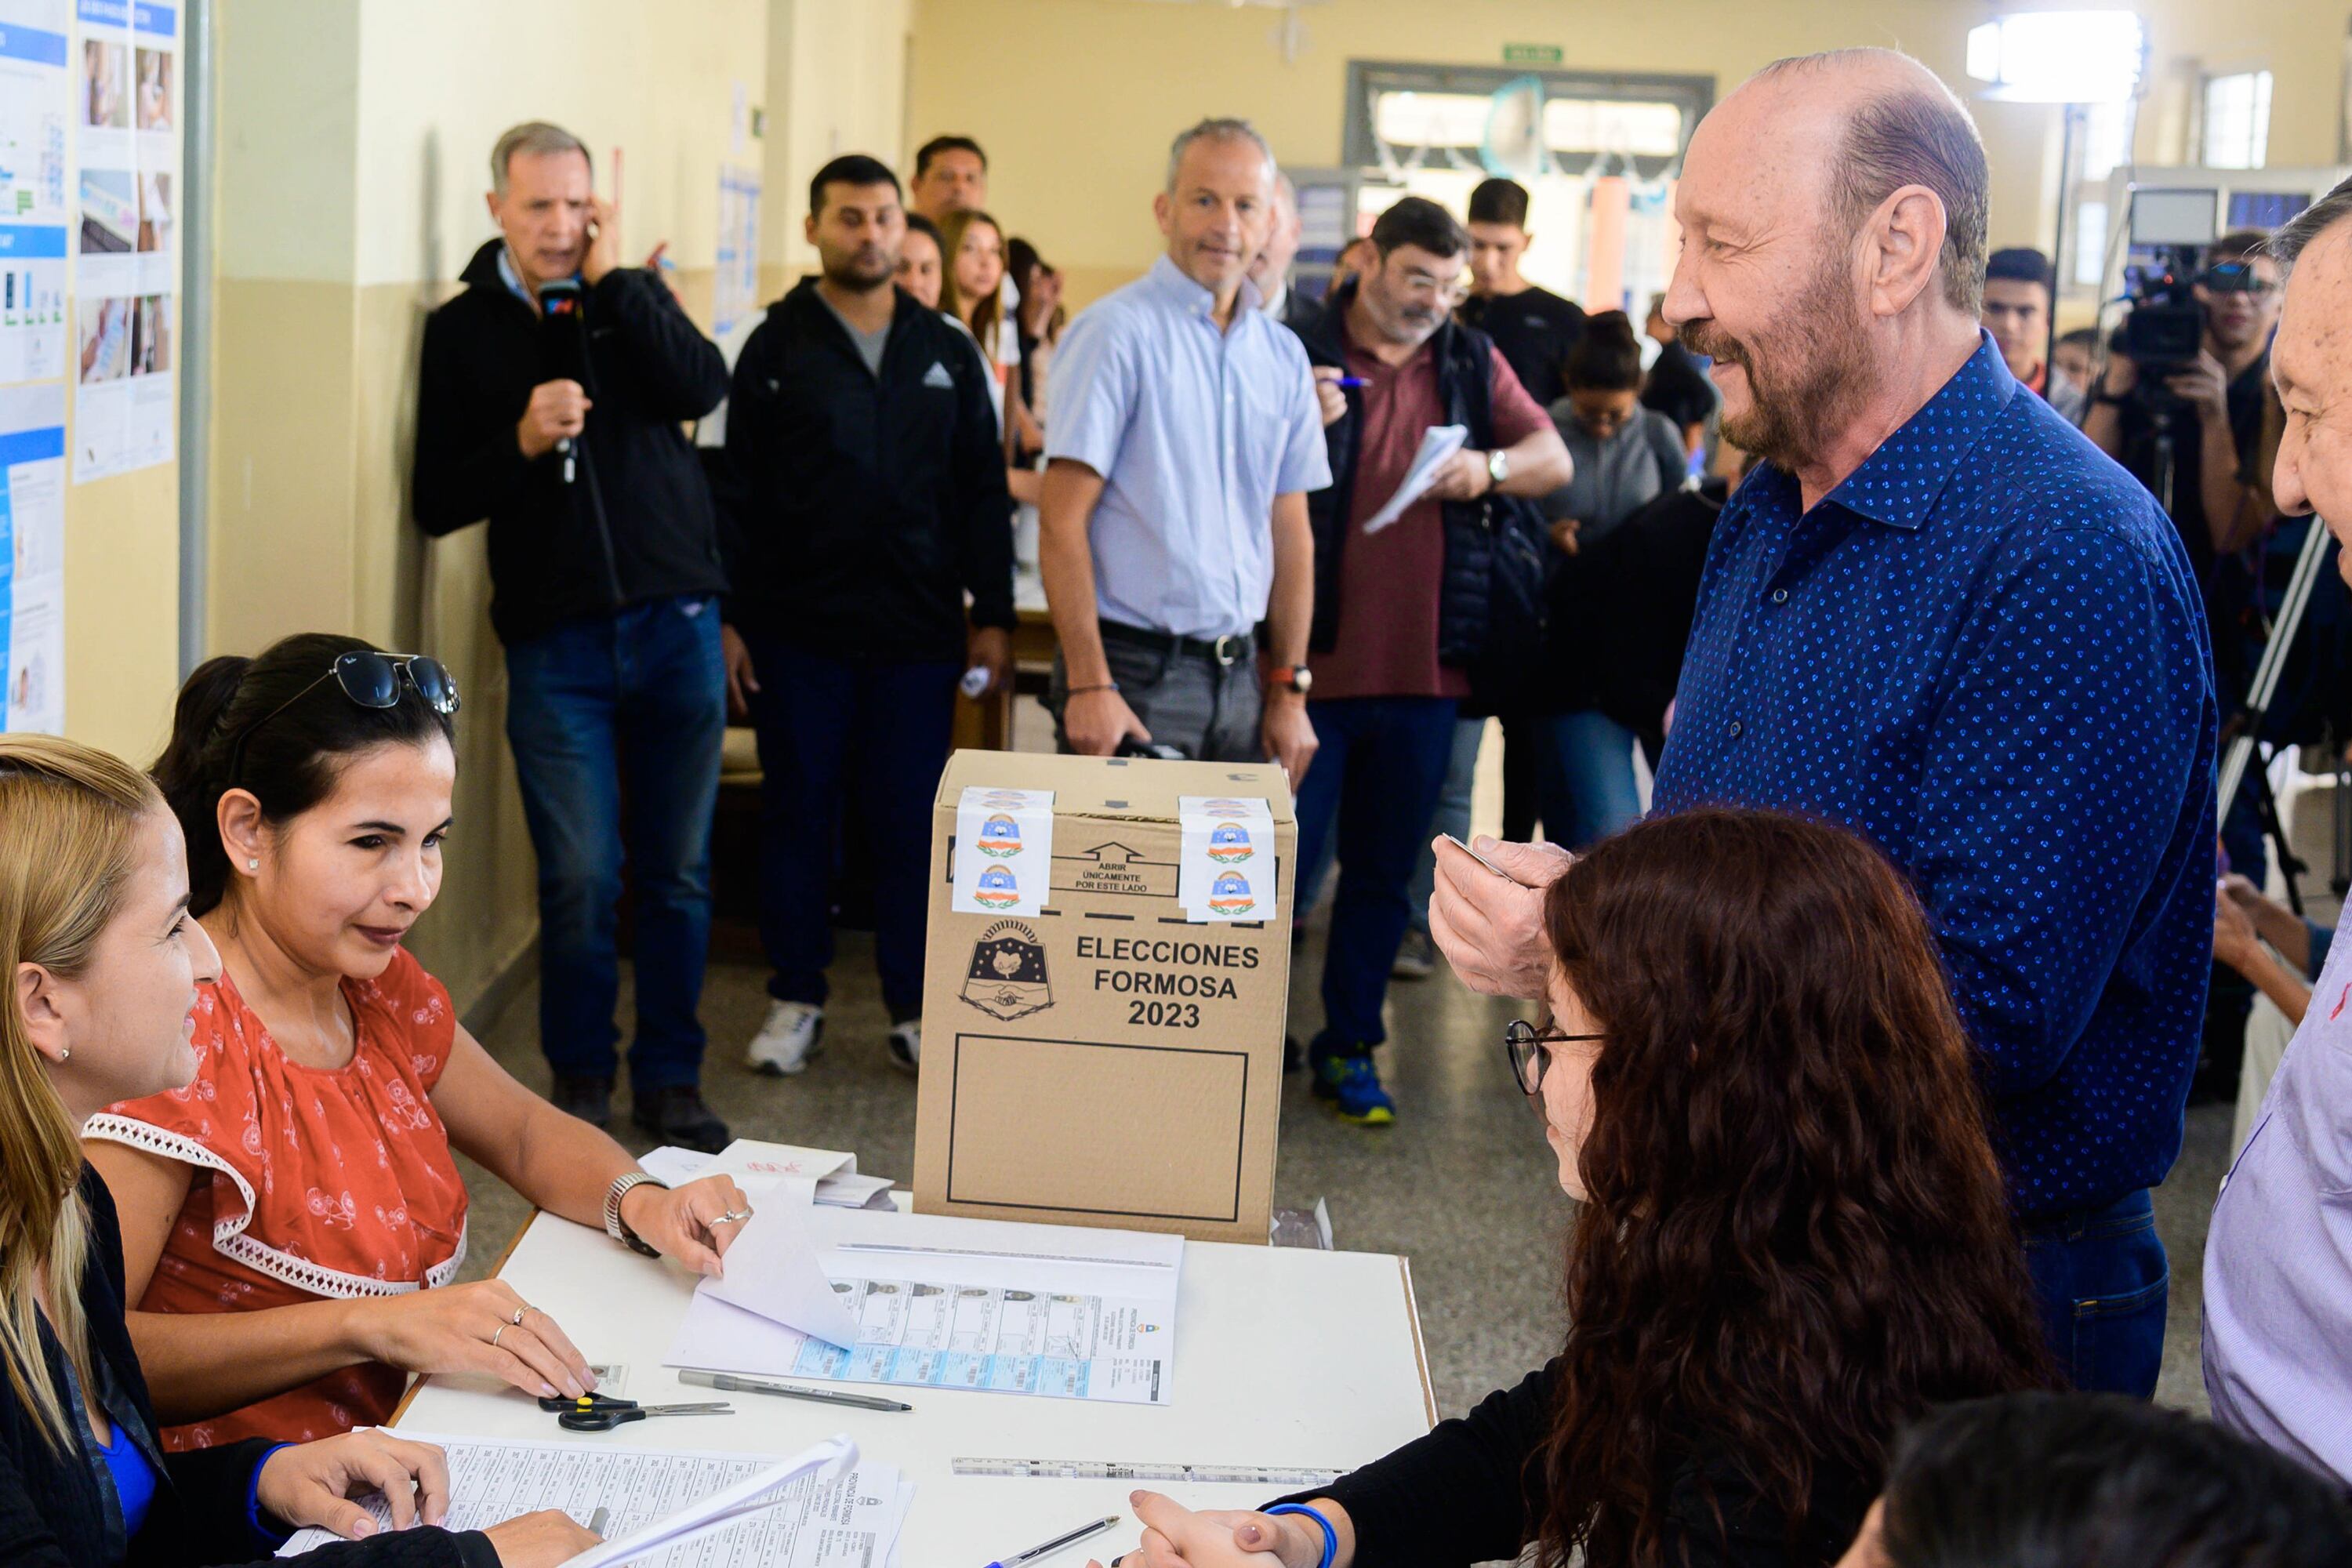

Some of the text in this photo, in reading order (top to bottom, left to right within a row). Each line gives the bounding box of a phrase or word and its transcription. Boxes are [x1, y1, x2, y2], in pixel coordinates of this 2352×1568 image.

[1083, 869, 1141, 882] ÚNICAMENTE
[1098, 862, 1127, 871] ABRIR
[1075, 880, 1147, 892] POR ESTE LADO
[1076, 936, 1259, 969] ELECCIONES
[1094, 969, 1238, 1000] FORMOSA
[1127, 1000, 1200, 1029] 2023
[846, 1472, 859, 1497] PROVINCIA
[840, 1504, 853, 1525] FORMOSA
